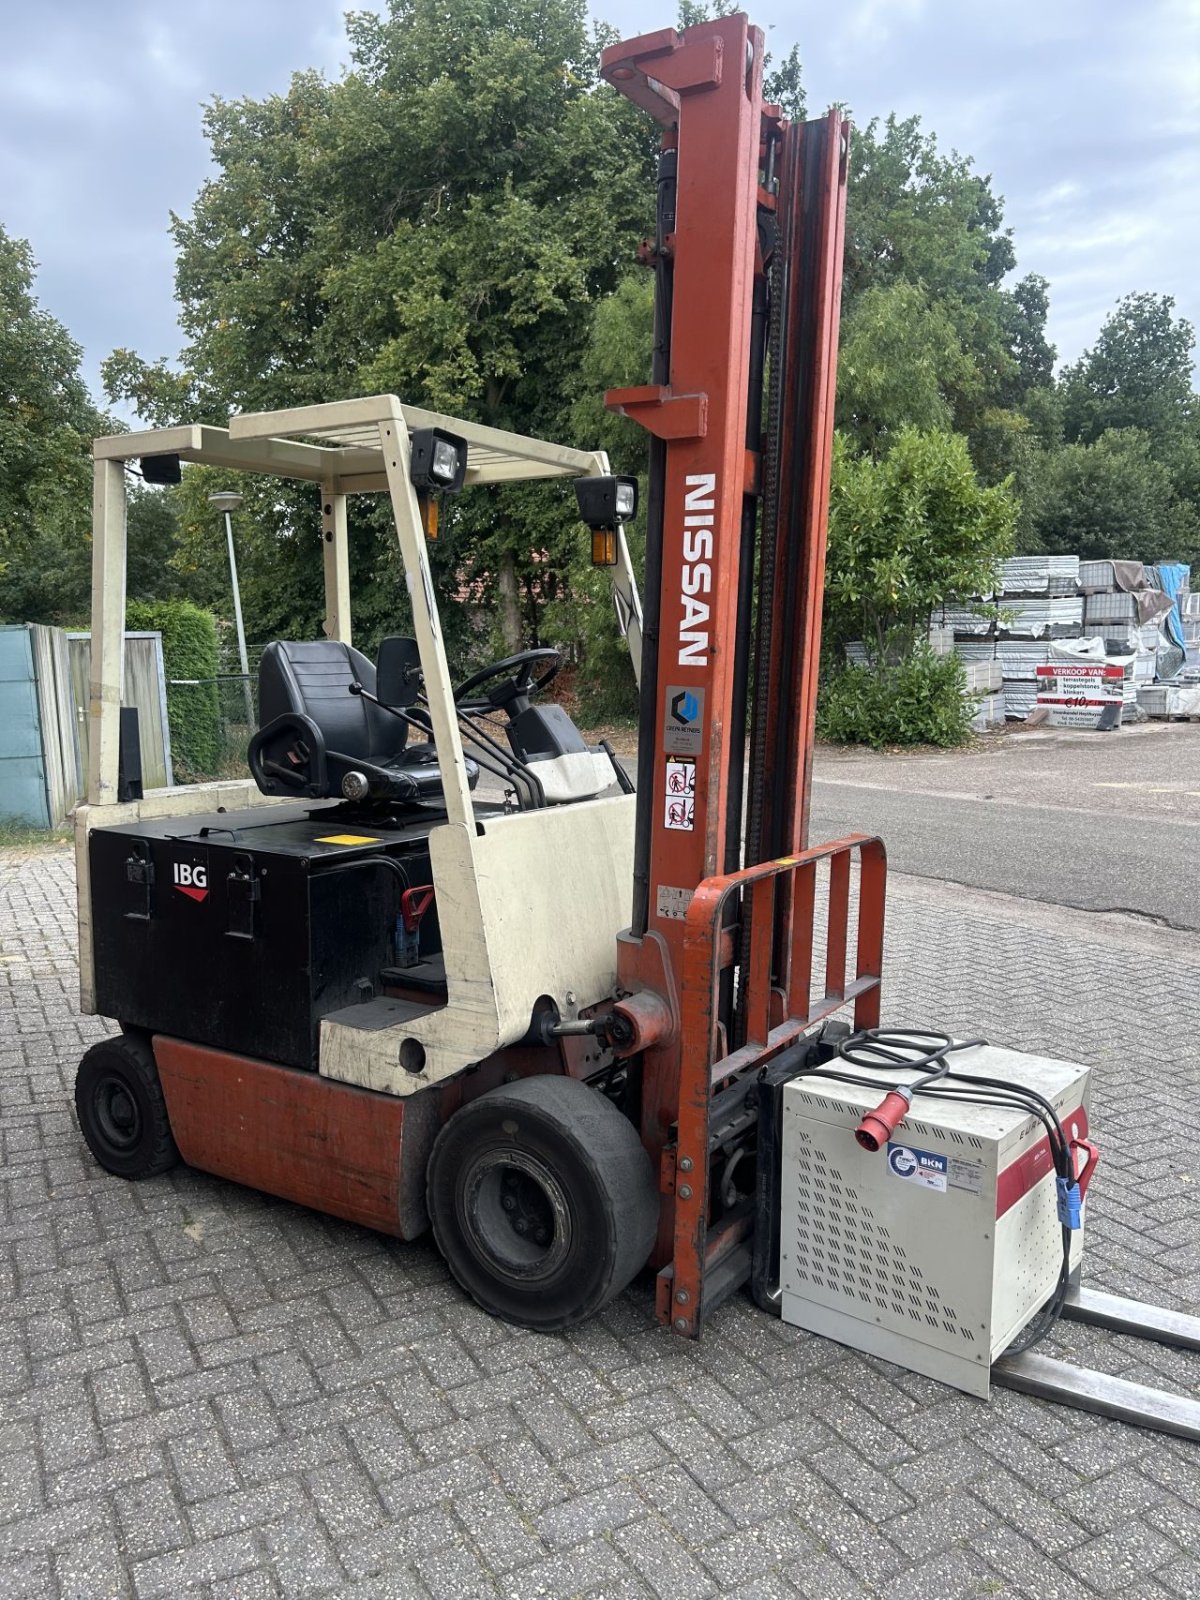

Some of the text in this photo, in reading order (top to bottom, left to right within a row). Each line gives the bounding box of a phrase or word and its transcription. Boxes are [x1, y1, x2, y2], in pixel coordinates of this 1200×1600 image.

[678, 473, 716, 666] NISSAN
[173, 862, 207, 888] IBG
[921, 1156, 943, 1170] BKN
